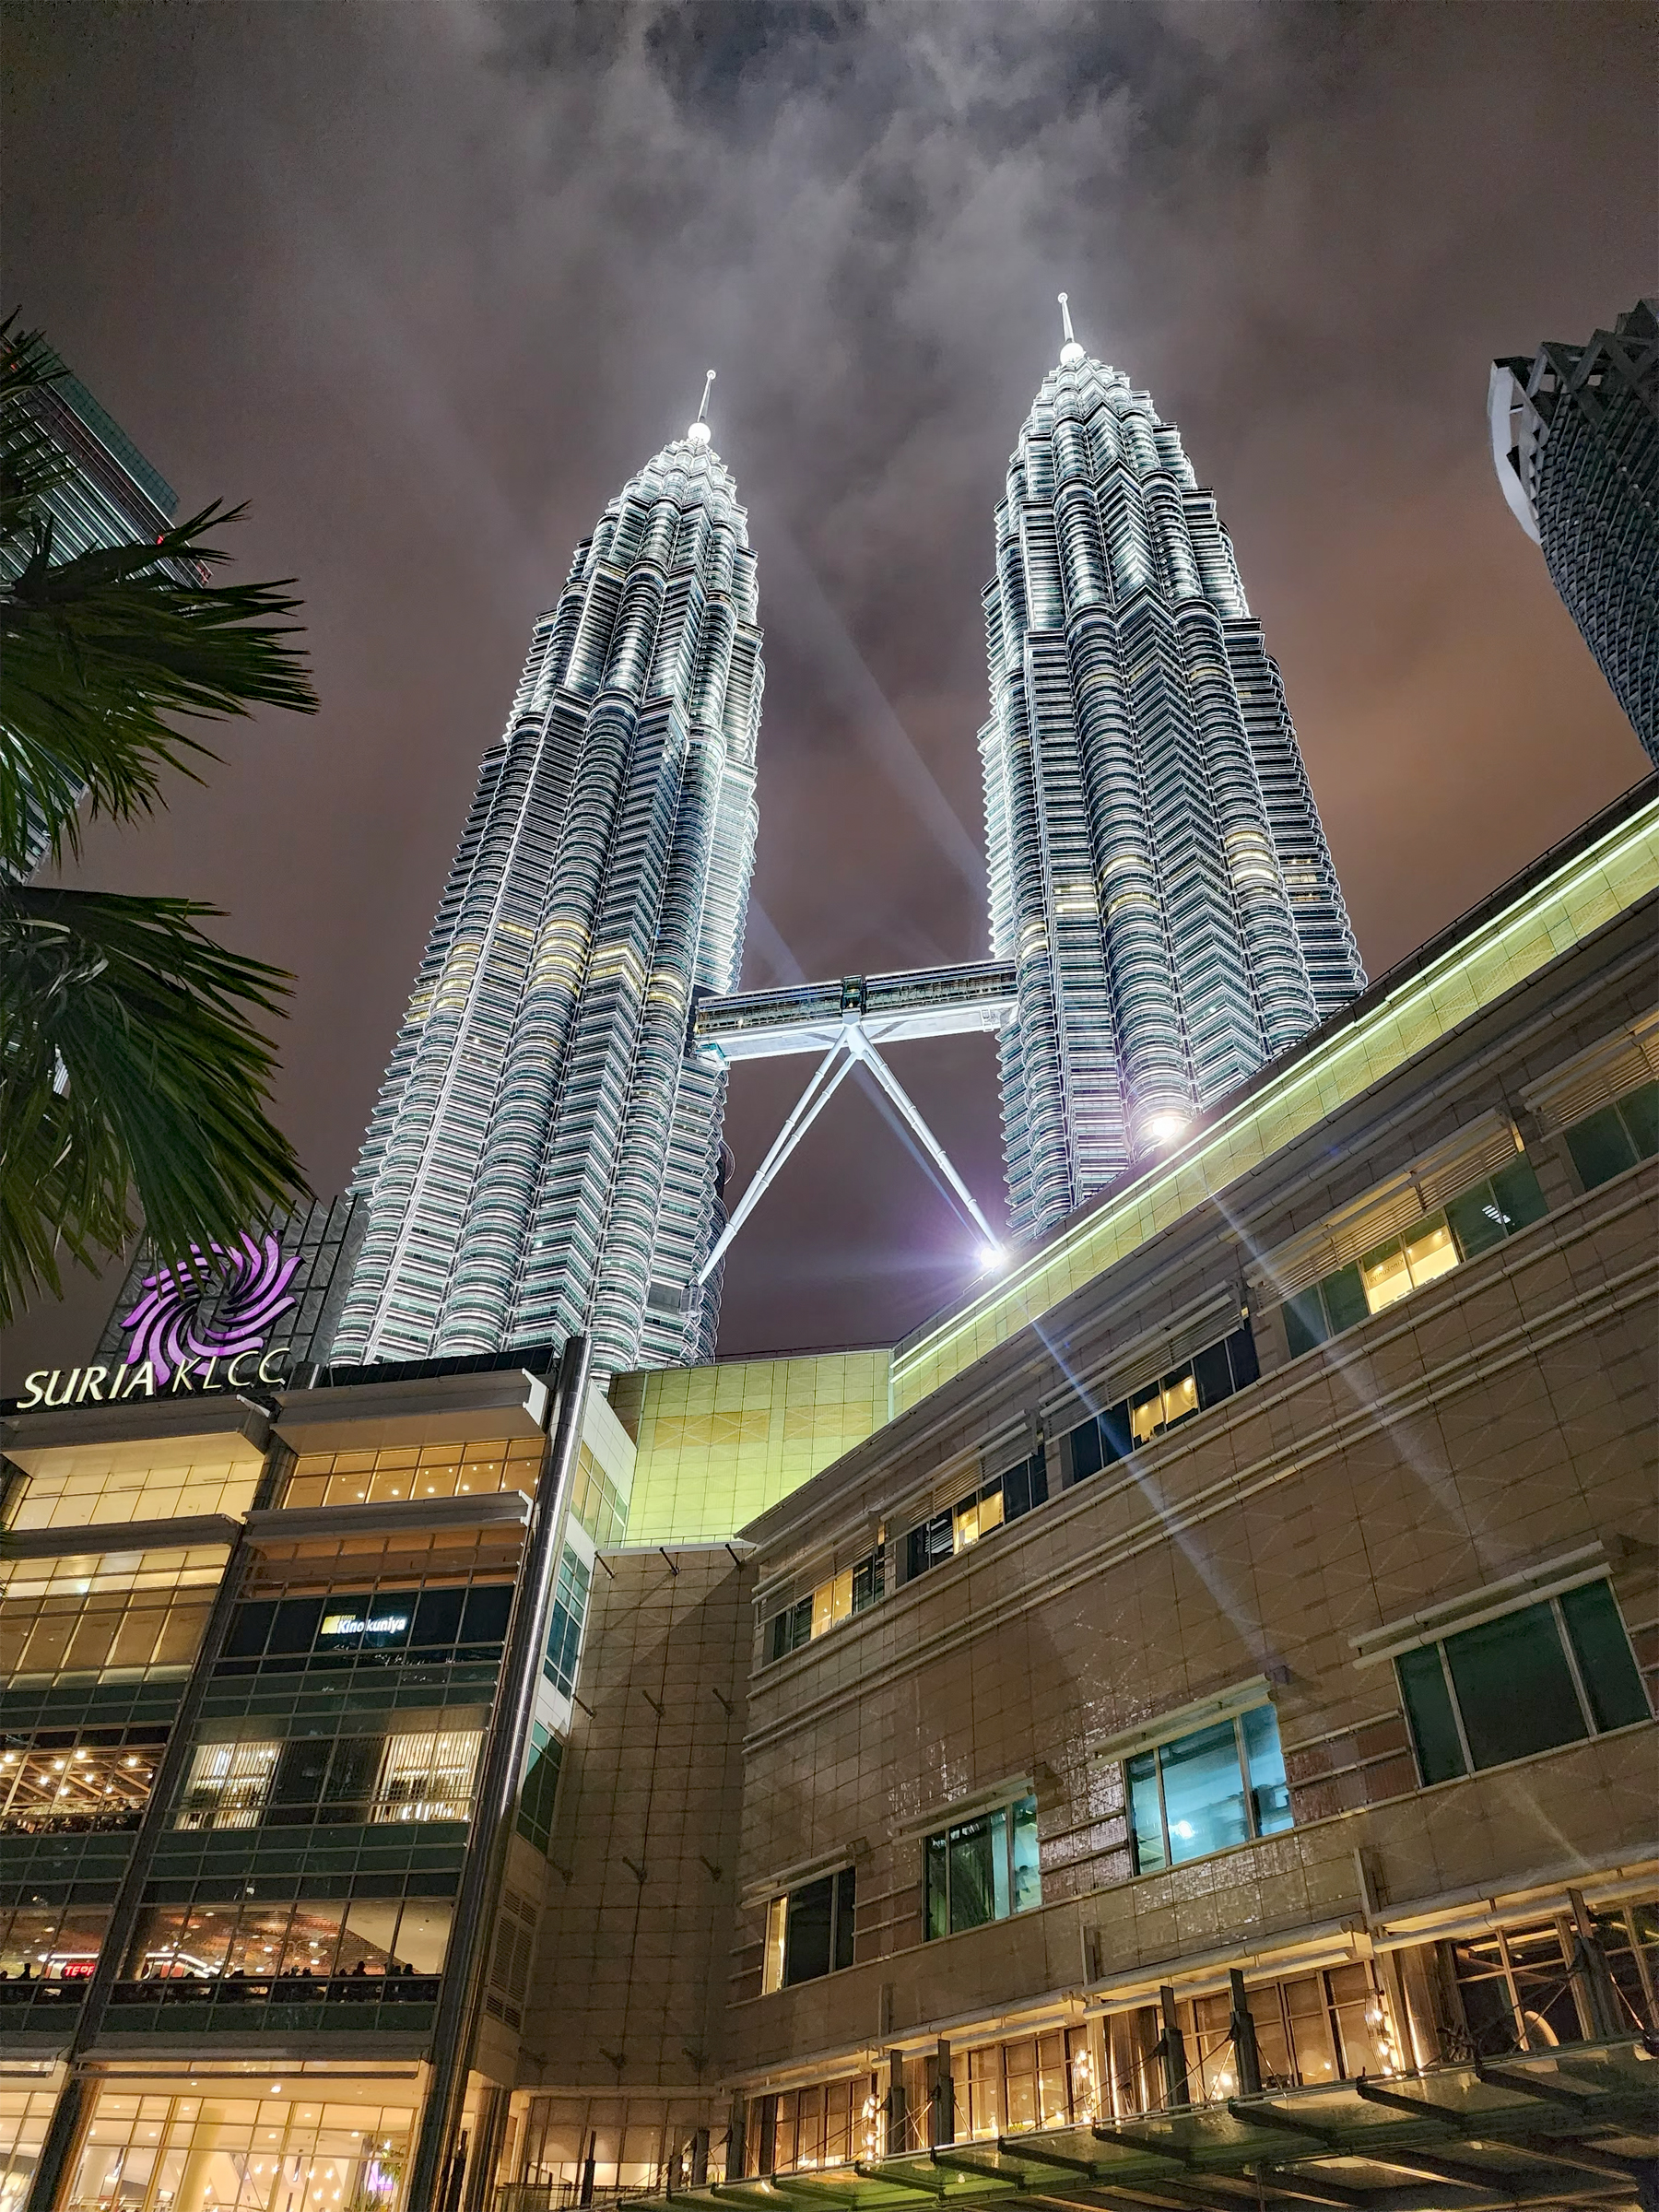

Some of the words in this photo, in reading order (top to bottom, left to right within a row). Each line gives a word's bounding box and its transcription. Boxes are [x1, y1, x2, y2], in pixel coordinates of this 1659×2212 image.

[17, 1361, 156, 1408] SURIA
[171, 1347, 290, 1393] KLCC
[337, 1616, 406, 1634] Kinokuniya
